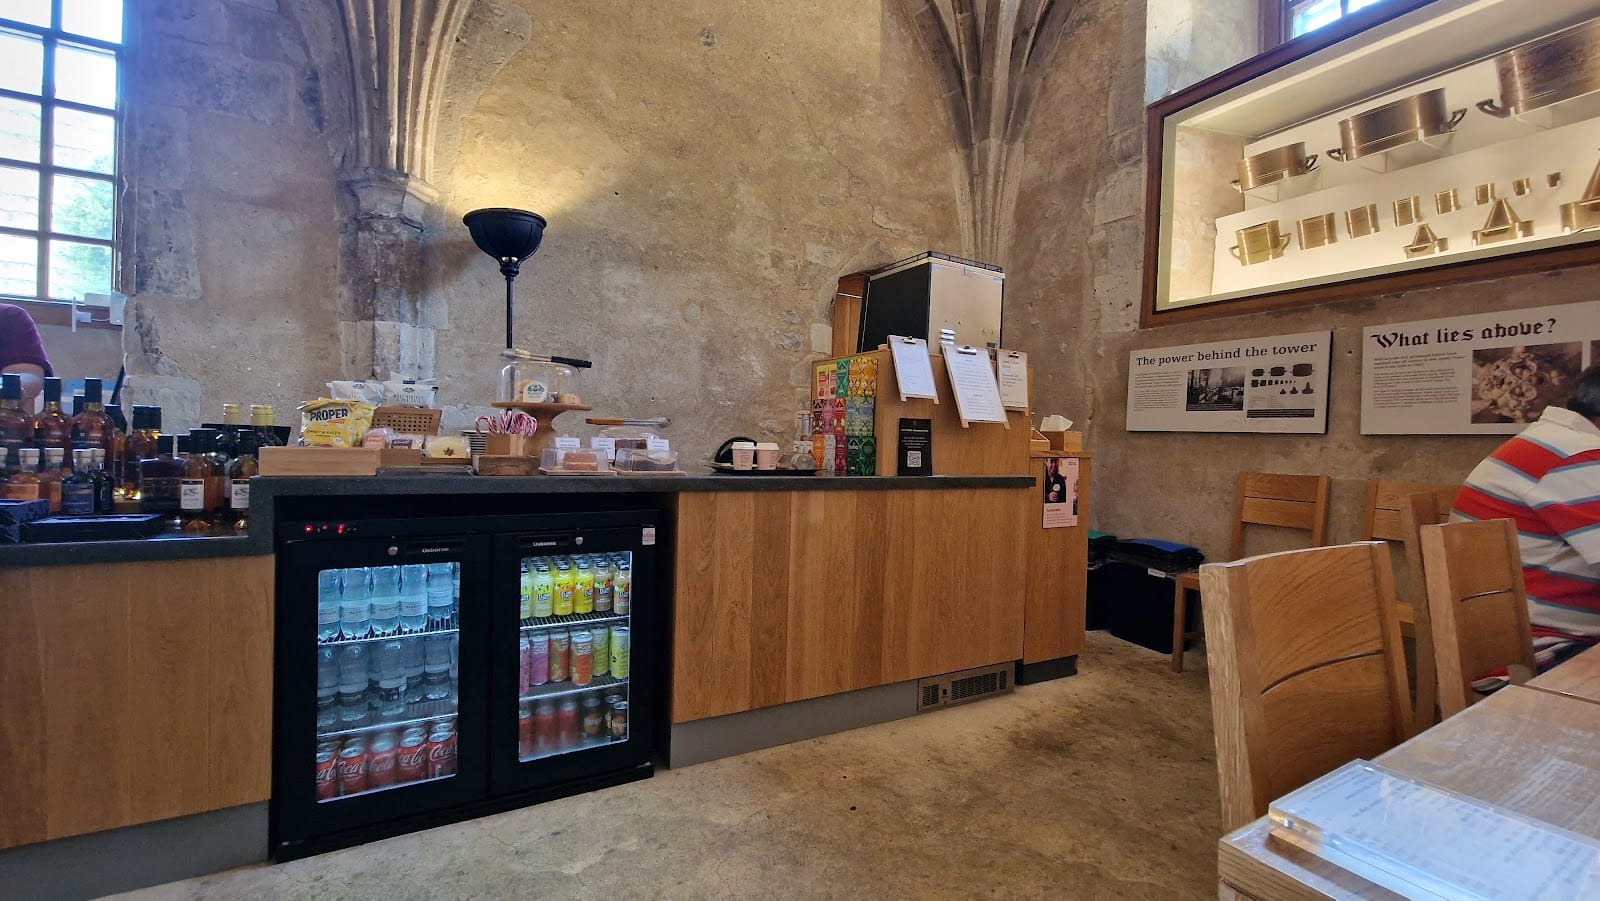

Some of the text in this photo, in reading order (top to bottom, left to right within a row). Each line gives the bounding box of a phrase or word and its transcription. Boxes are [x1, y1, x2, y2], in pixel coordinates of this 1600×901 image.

[1370, 318, 1556, 348] What lies above?
[1136, 342, 1317, 366] The power behind the tower
[310, 408, 348, 421] PROPER
